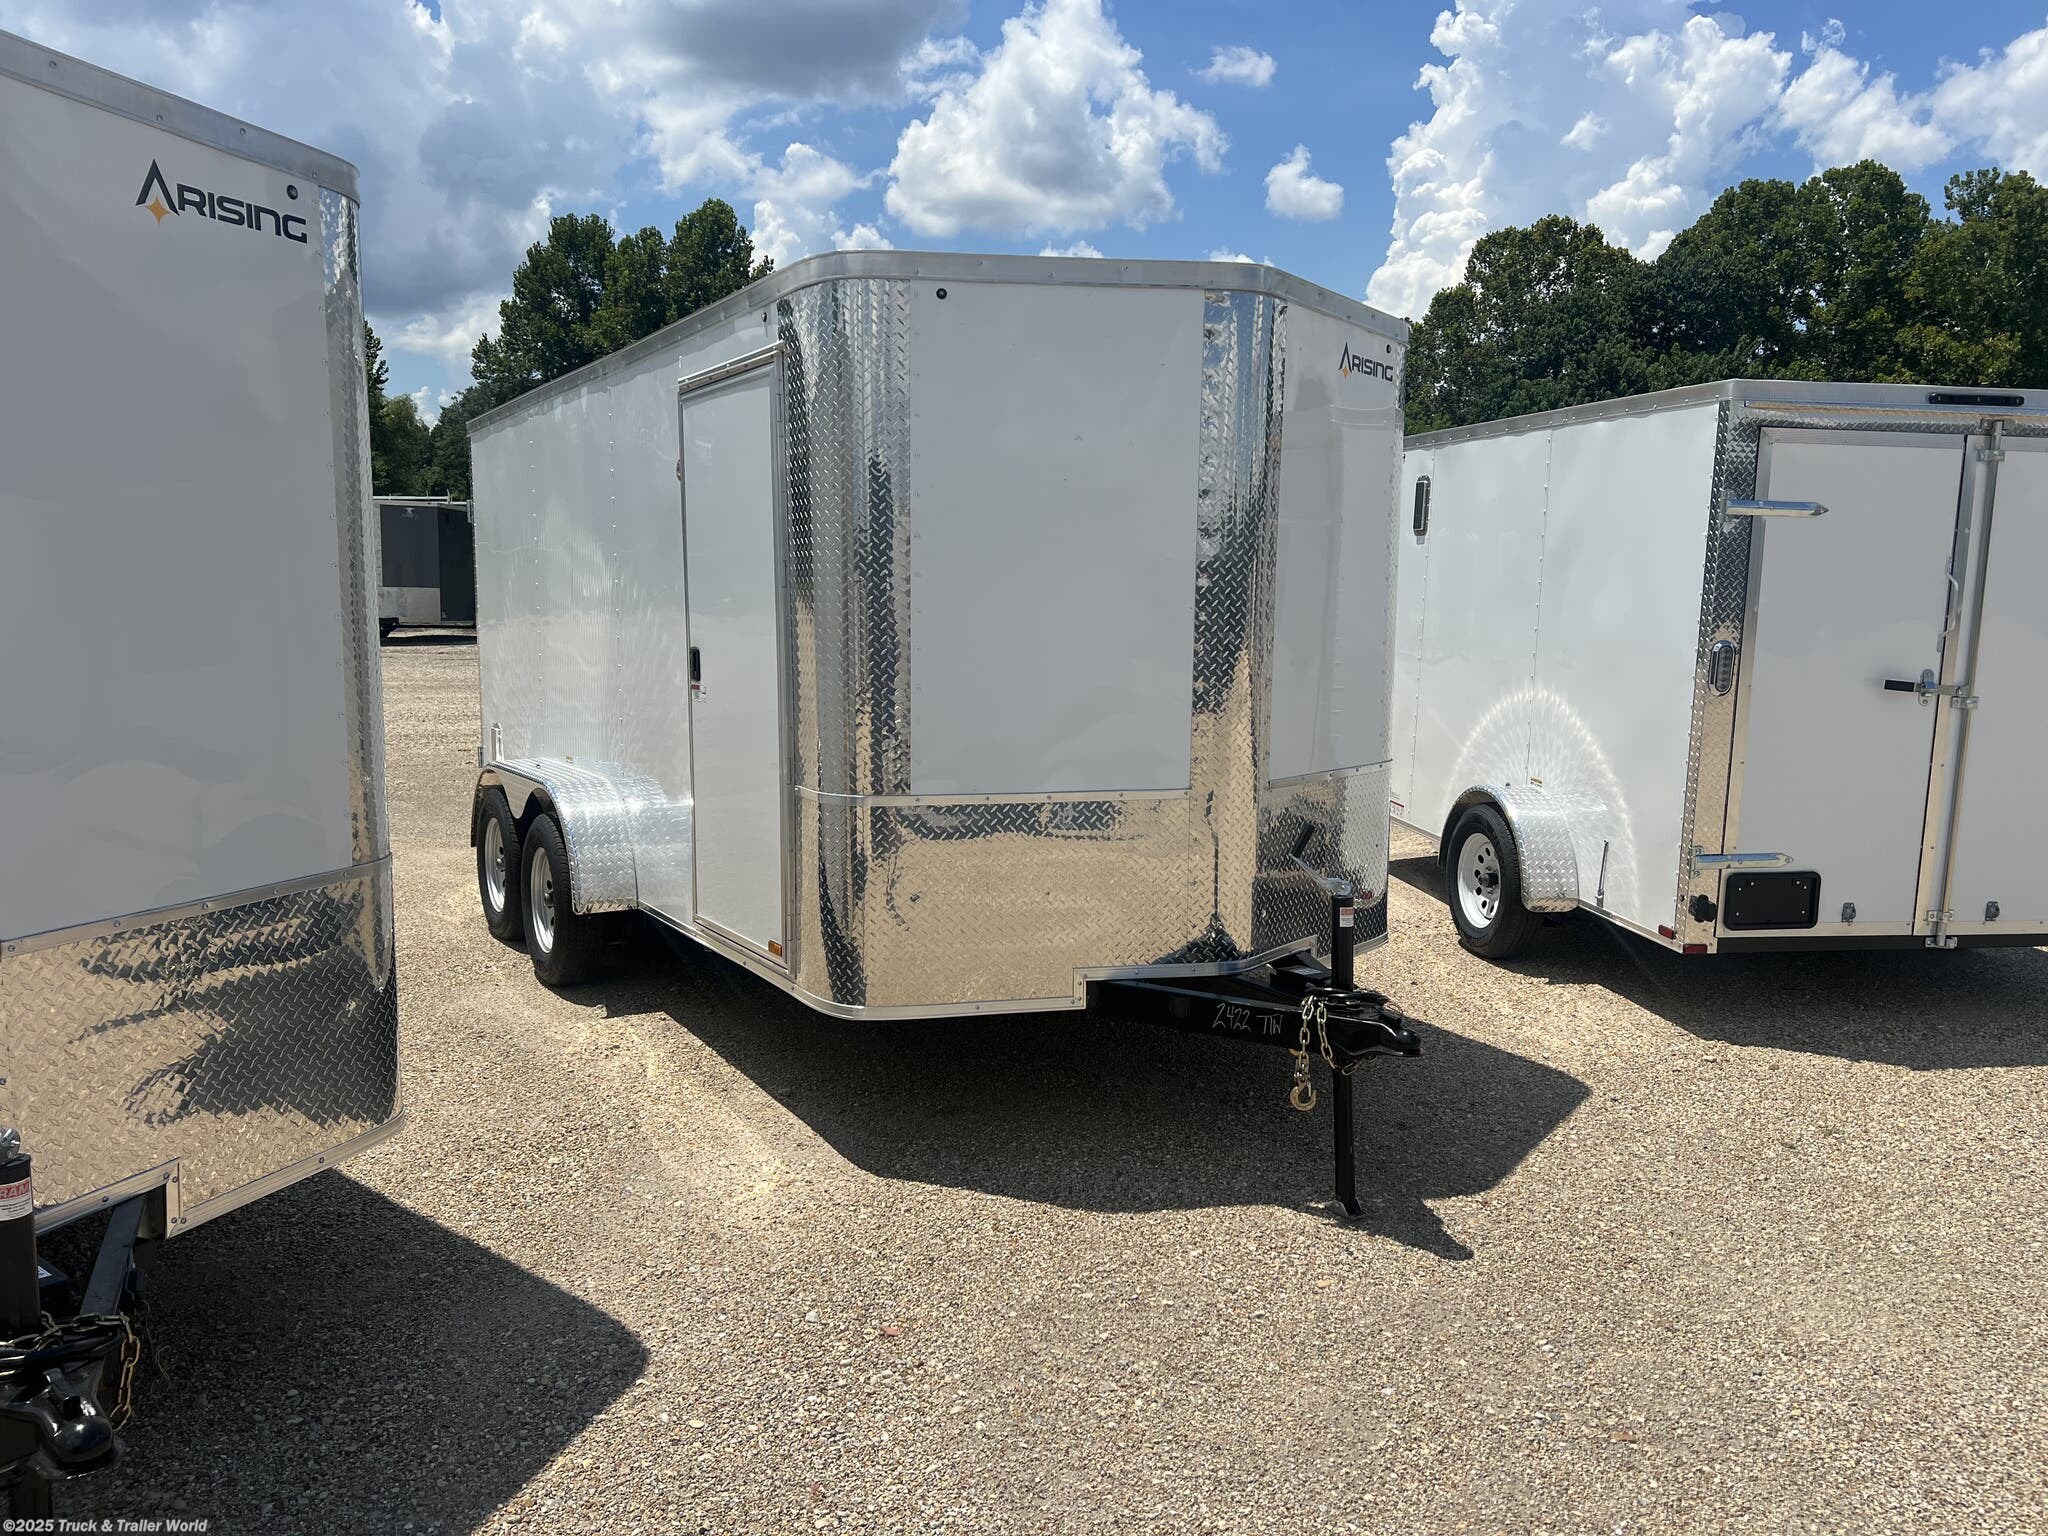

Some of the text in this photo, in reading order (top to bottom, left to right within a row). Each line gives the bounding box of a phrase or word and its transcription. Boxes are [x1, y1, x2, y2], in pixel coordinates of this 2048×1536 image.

[136, 158, 308, 244] ARISING
[1338, 341, 1394, 382] ARISING
[1212, 1002, 1252, 1033] 2422
